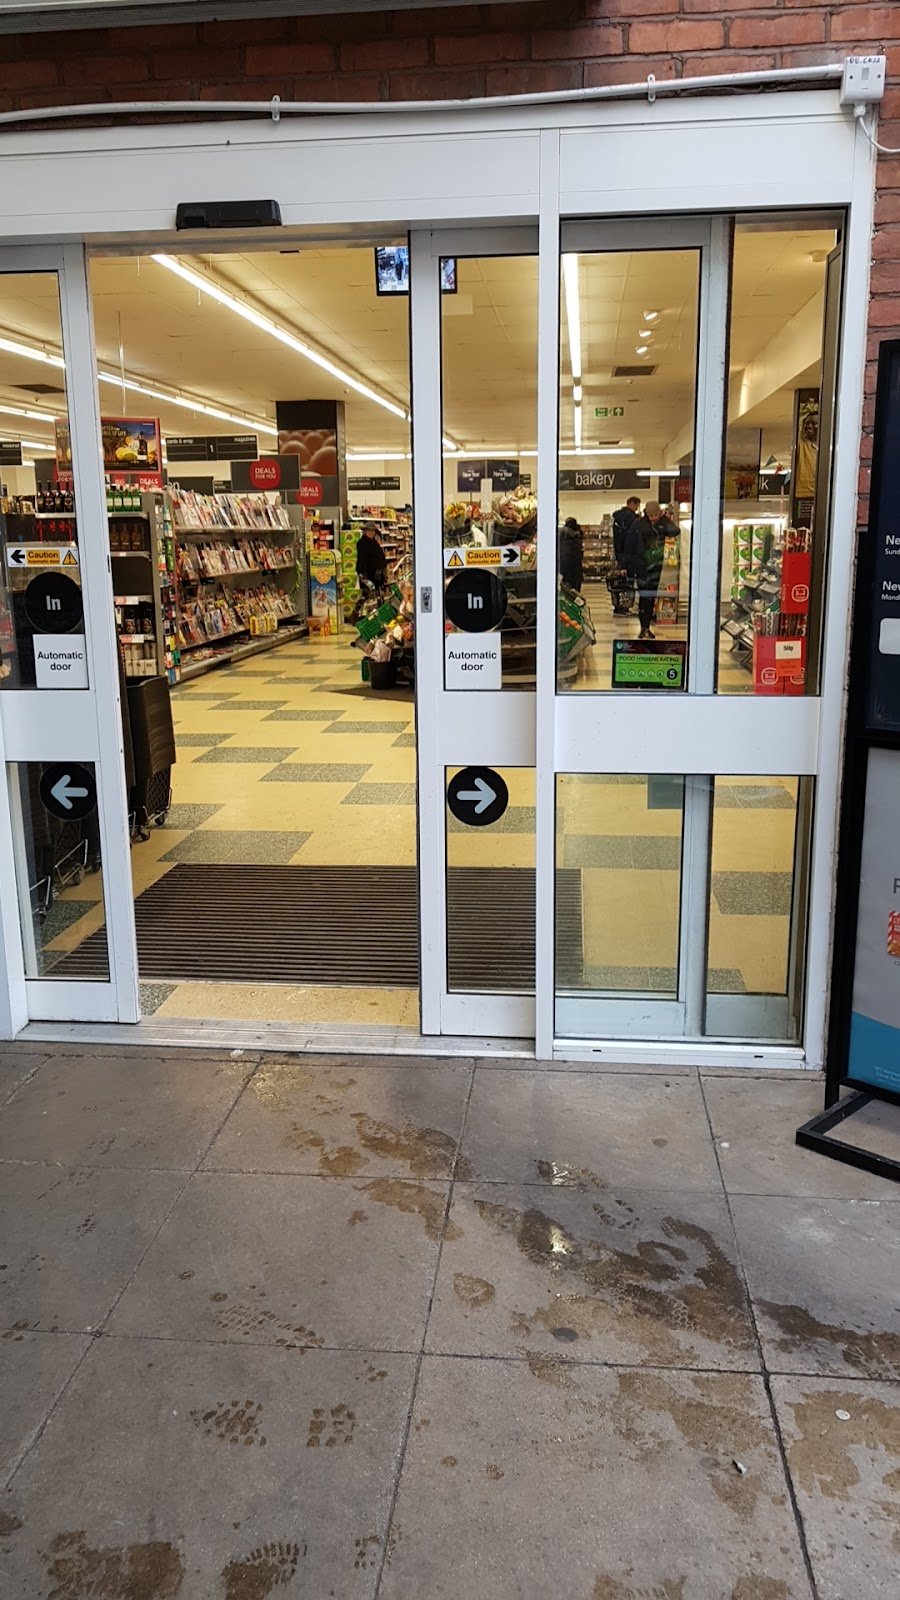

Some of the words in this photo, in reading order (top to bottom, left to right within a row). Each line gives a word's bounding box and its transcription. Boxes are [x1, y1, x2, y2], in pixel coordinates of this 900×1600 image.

[210, 444, 214, 452] 1
[576, 472, 616, 487] bakery
[468, 551, 500, 559] Caution
[46, 595, 61, 610] In
[467, 593, 483, 609] In
[37, 651, 83, 660] Automatic
[448, 651, 496, 660] Automatic
[50, 662, 71, 671] door
[460, 663, 483, 671] door
[669, 670, 675, 678] 5
